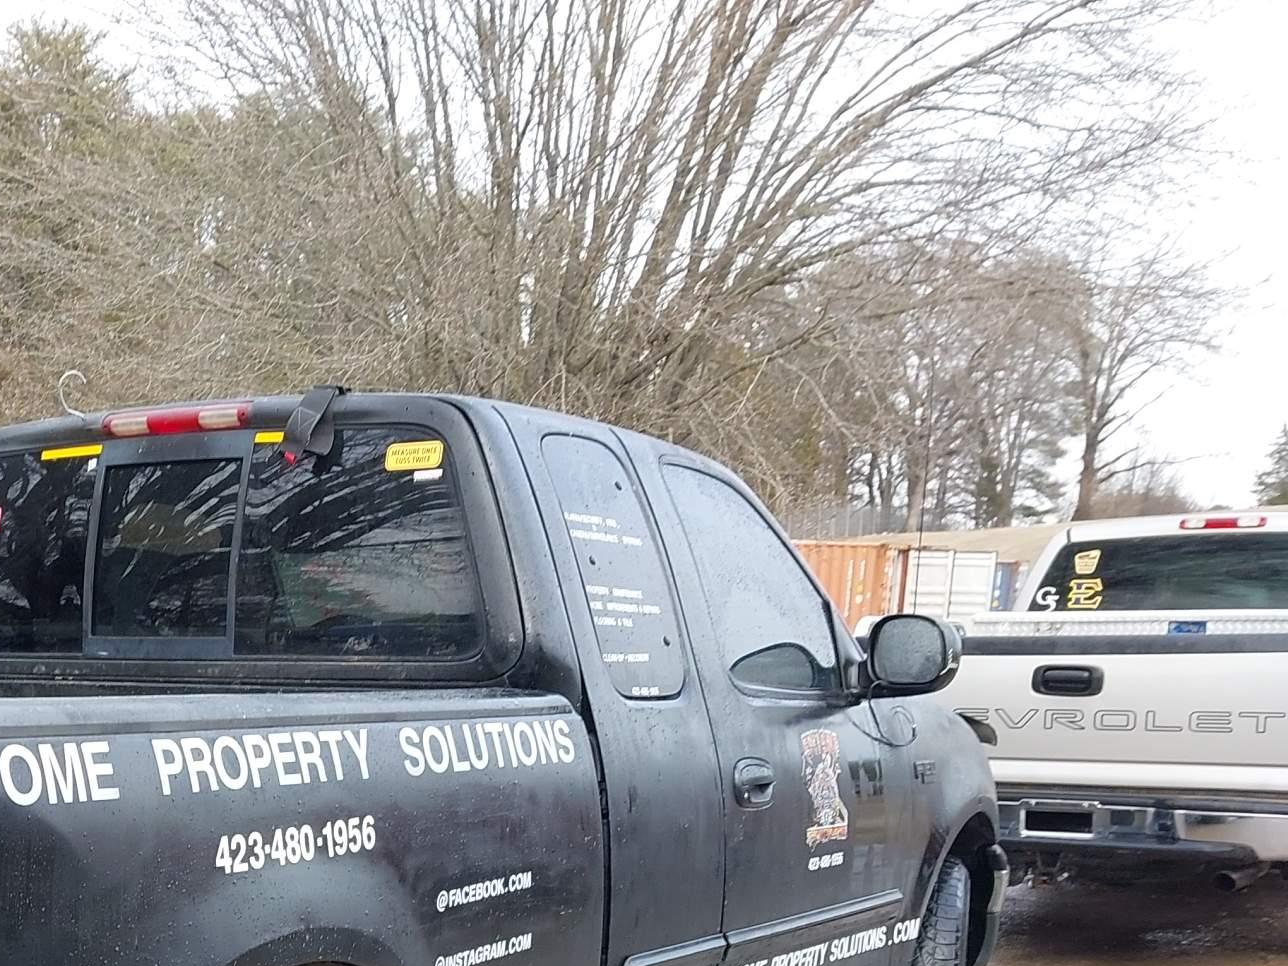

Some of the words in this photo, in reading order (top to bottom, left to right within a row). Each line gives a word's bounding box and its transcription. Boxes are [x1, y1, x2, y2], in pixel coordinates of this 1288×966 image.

[152, 729, 370, 796] PROPERTY
[399, 719, 576, 778] SOLUTIONS
[436, 871, 532, 913] @FACEBOOK.COM
